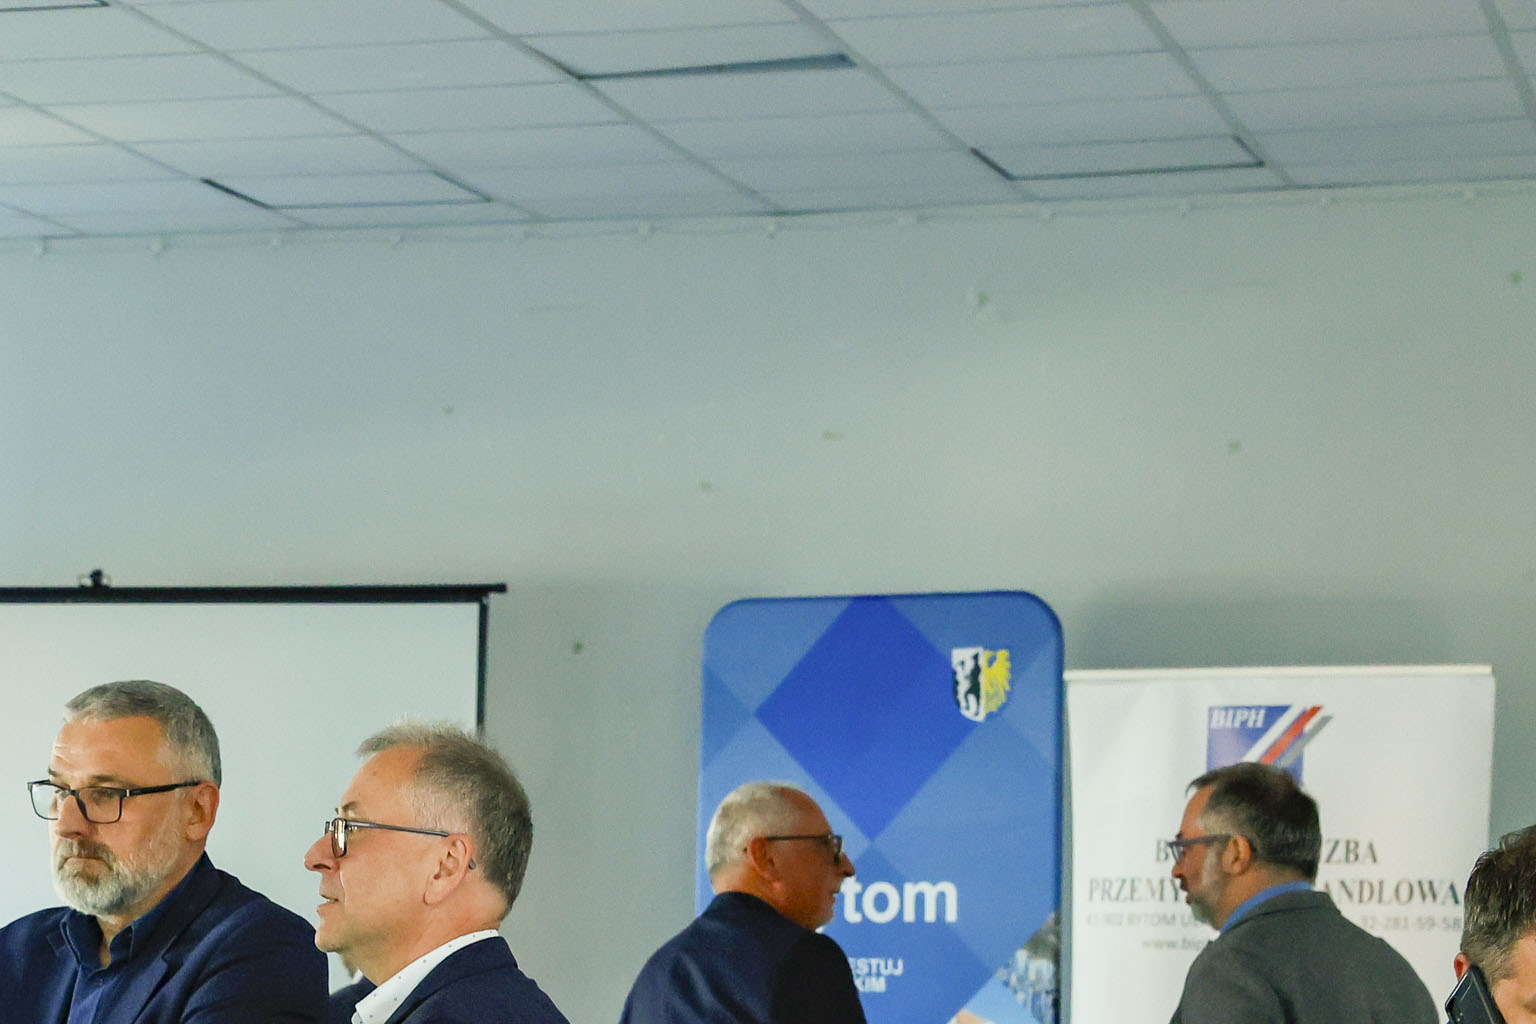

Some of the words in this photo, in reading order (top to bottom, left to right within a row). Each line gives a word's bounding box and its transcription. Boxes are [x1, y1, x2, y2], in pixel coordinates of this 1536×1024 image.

[1210, 709, 1265, 728] BIPH
[1325, 839, 1377, 864] ZBA
[836, 876, 958, 924] tom
[1089, 878, 1182, 902] PRZEMY
[1324, 880, 1460, 905] NDLOWA
